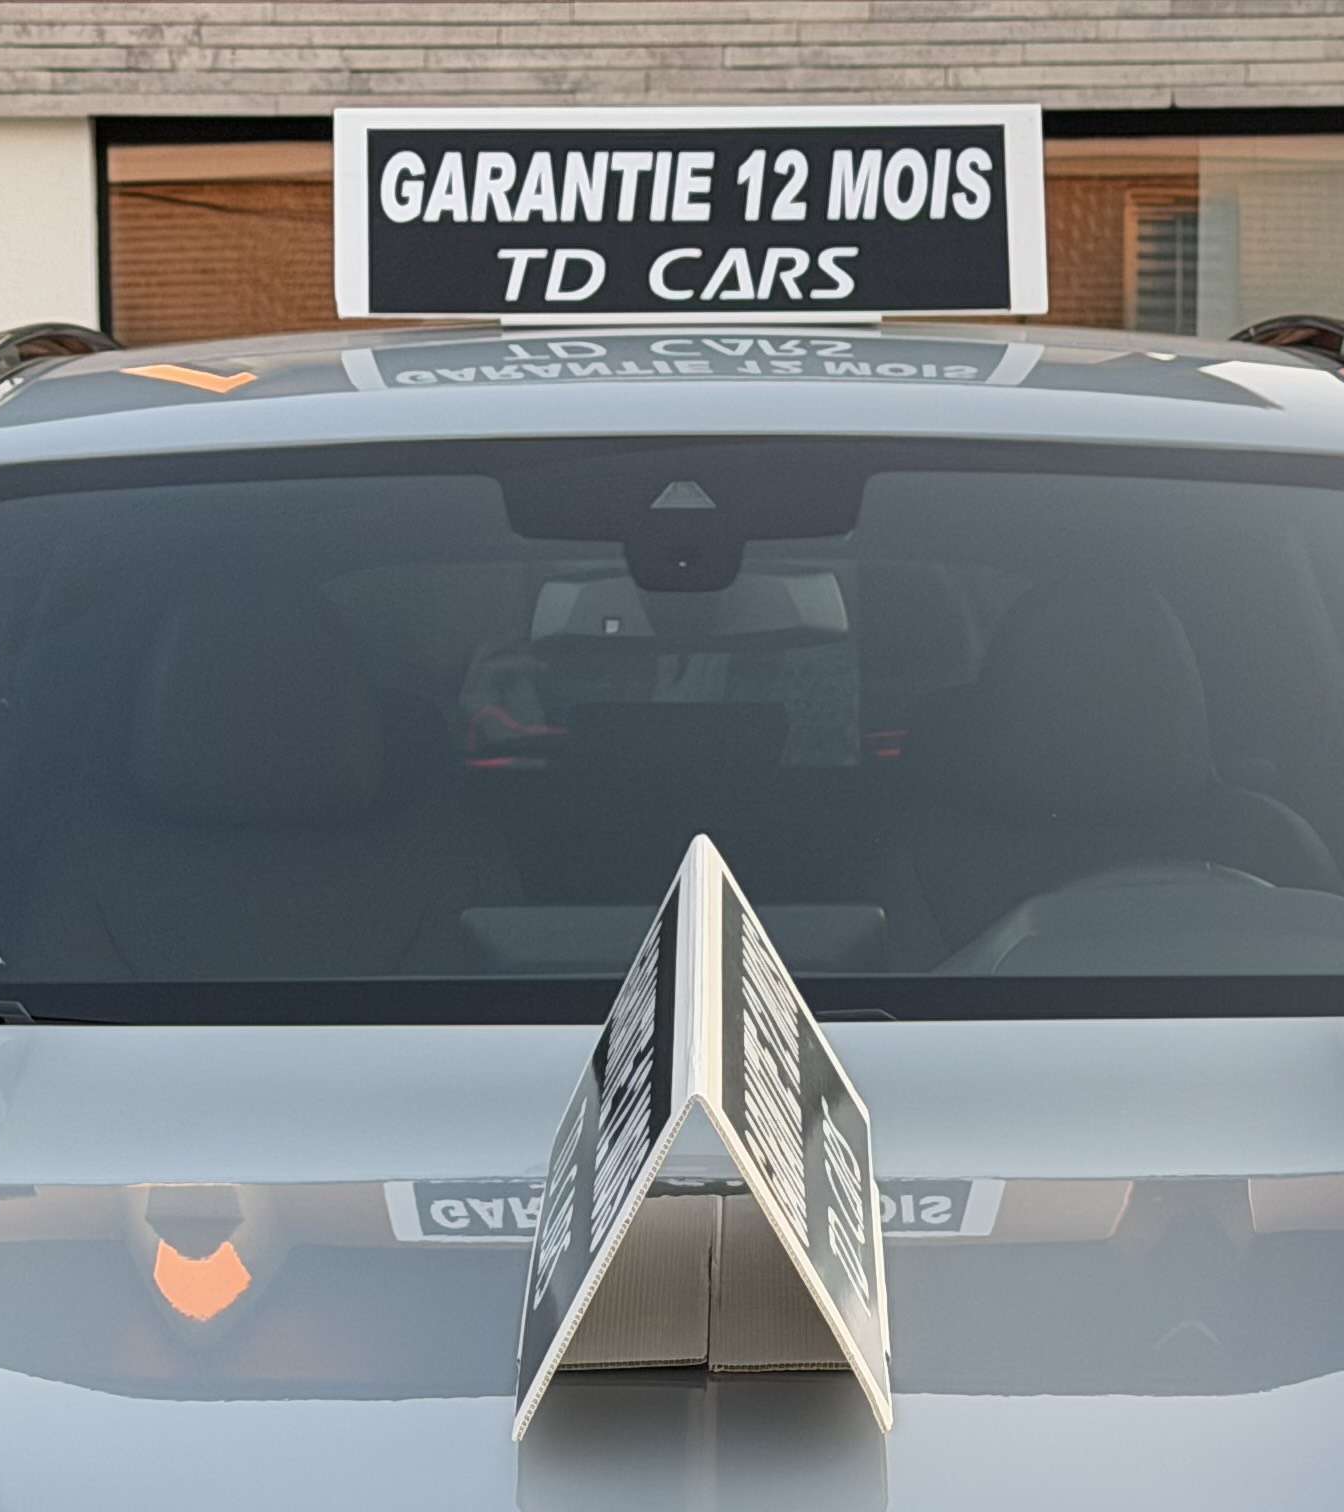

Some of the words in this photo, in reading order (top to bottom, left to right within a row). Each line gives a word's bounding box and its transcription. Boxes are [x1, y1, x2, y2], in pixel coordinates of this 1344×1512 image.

[380, 150, 715, 224] GARANTIE
[736, 148, 809, 222] 12
[826, 147, 993, 221] MOIS
[497, 248, 606, 302] TD
[648, 246, 859, 301] CARS
